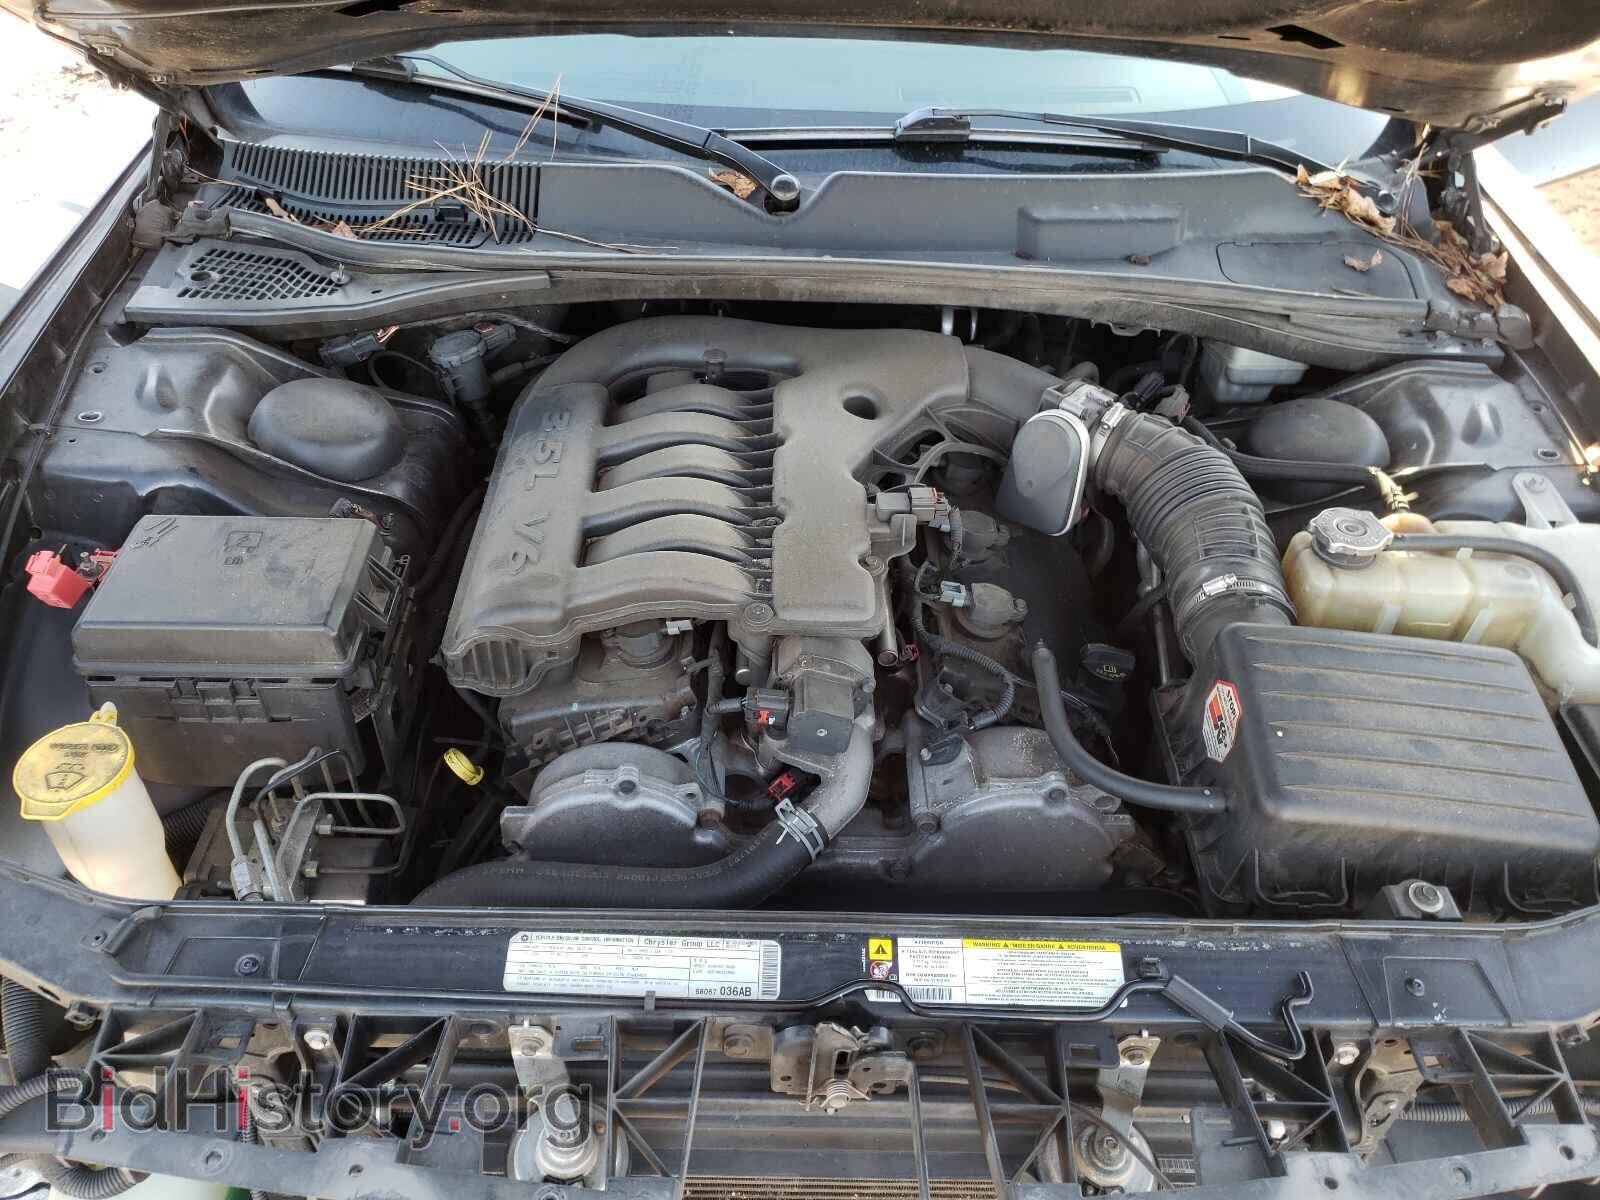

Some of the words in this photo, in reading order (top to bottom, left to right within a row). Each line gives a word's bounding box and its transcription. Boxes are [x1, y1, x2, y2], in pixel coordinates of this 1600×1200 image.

[525, 409, 573, 490] 3.5L
[508, 512, 553, 577] V6
[644, 938, 677, 947] Chrysler
[681, 939, 703, 948] Group
[706, 940, 720, 948] LLC
[719, 986, 752, 997] 036AB
